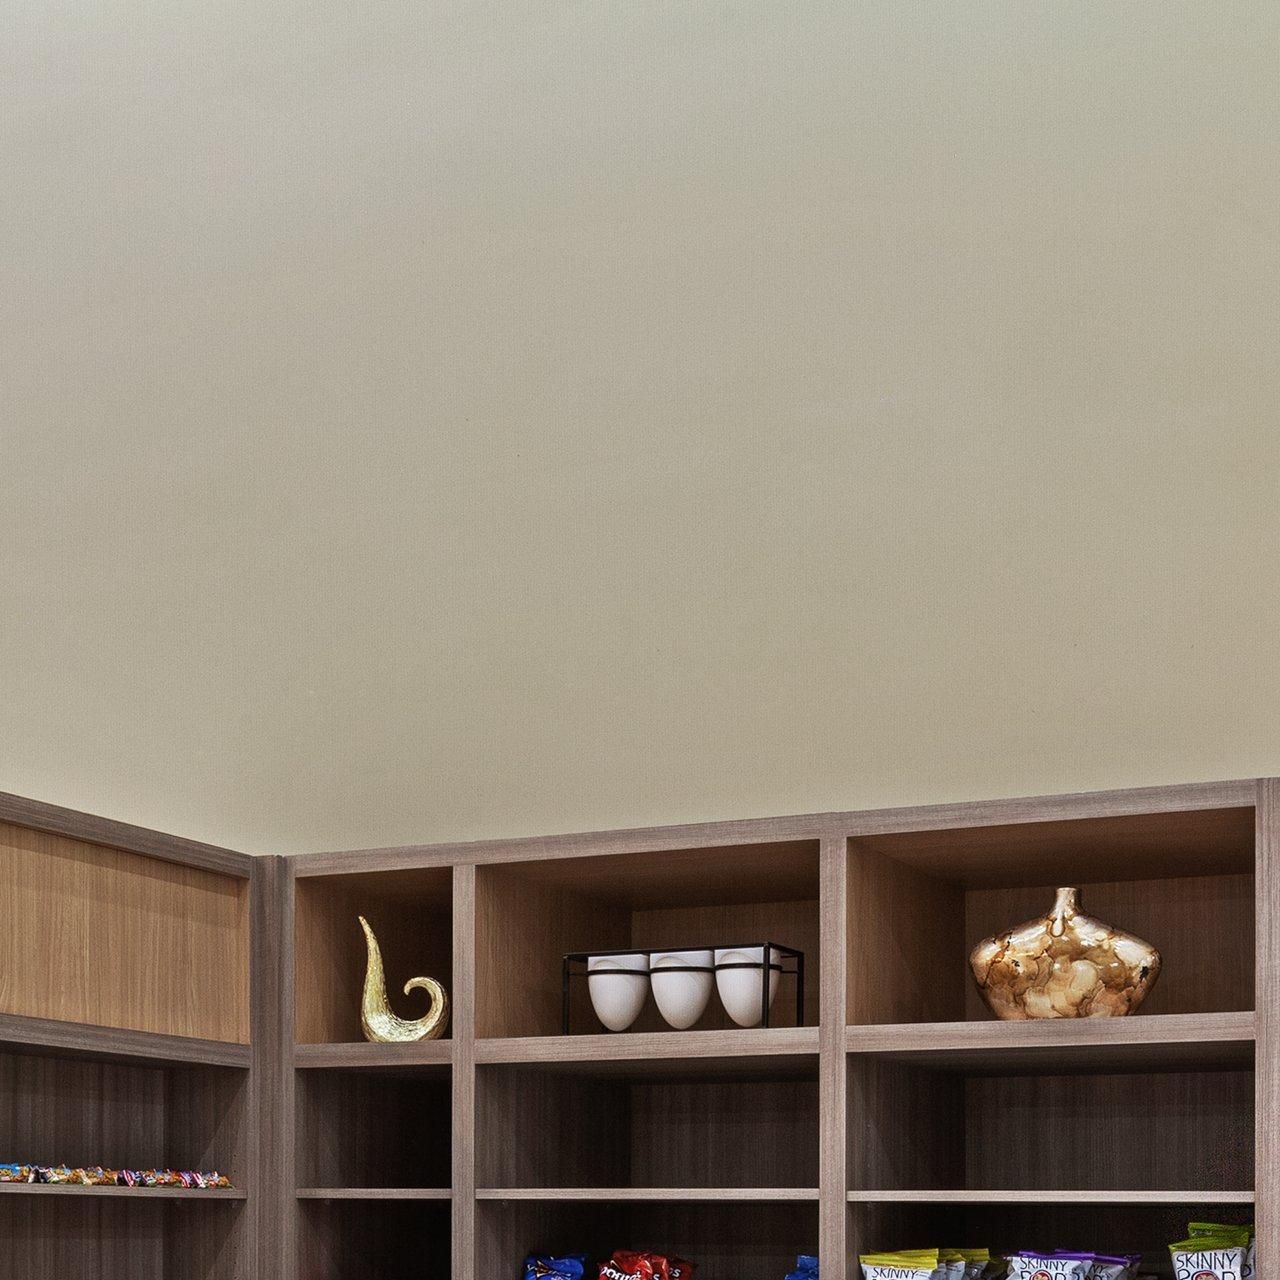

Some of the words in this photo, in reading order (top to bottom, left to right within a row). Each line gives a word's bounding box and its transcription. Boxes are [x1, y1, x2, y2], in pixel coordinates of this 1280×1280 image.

[1019, 1257, 1068, 1272] SKINNY
[1176, 1252, 1238, 1271] SKINNY
[872, 1266, 919, 1280] SKINNY
